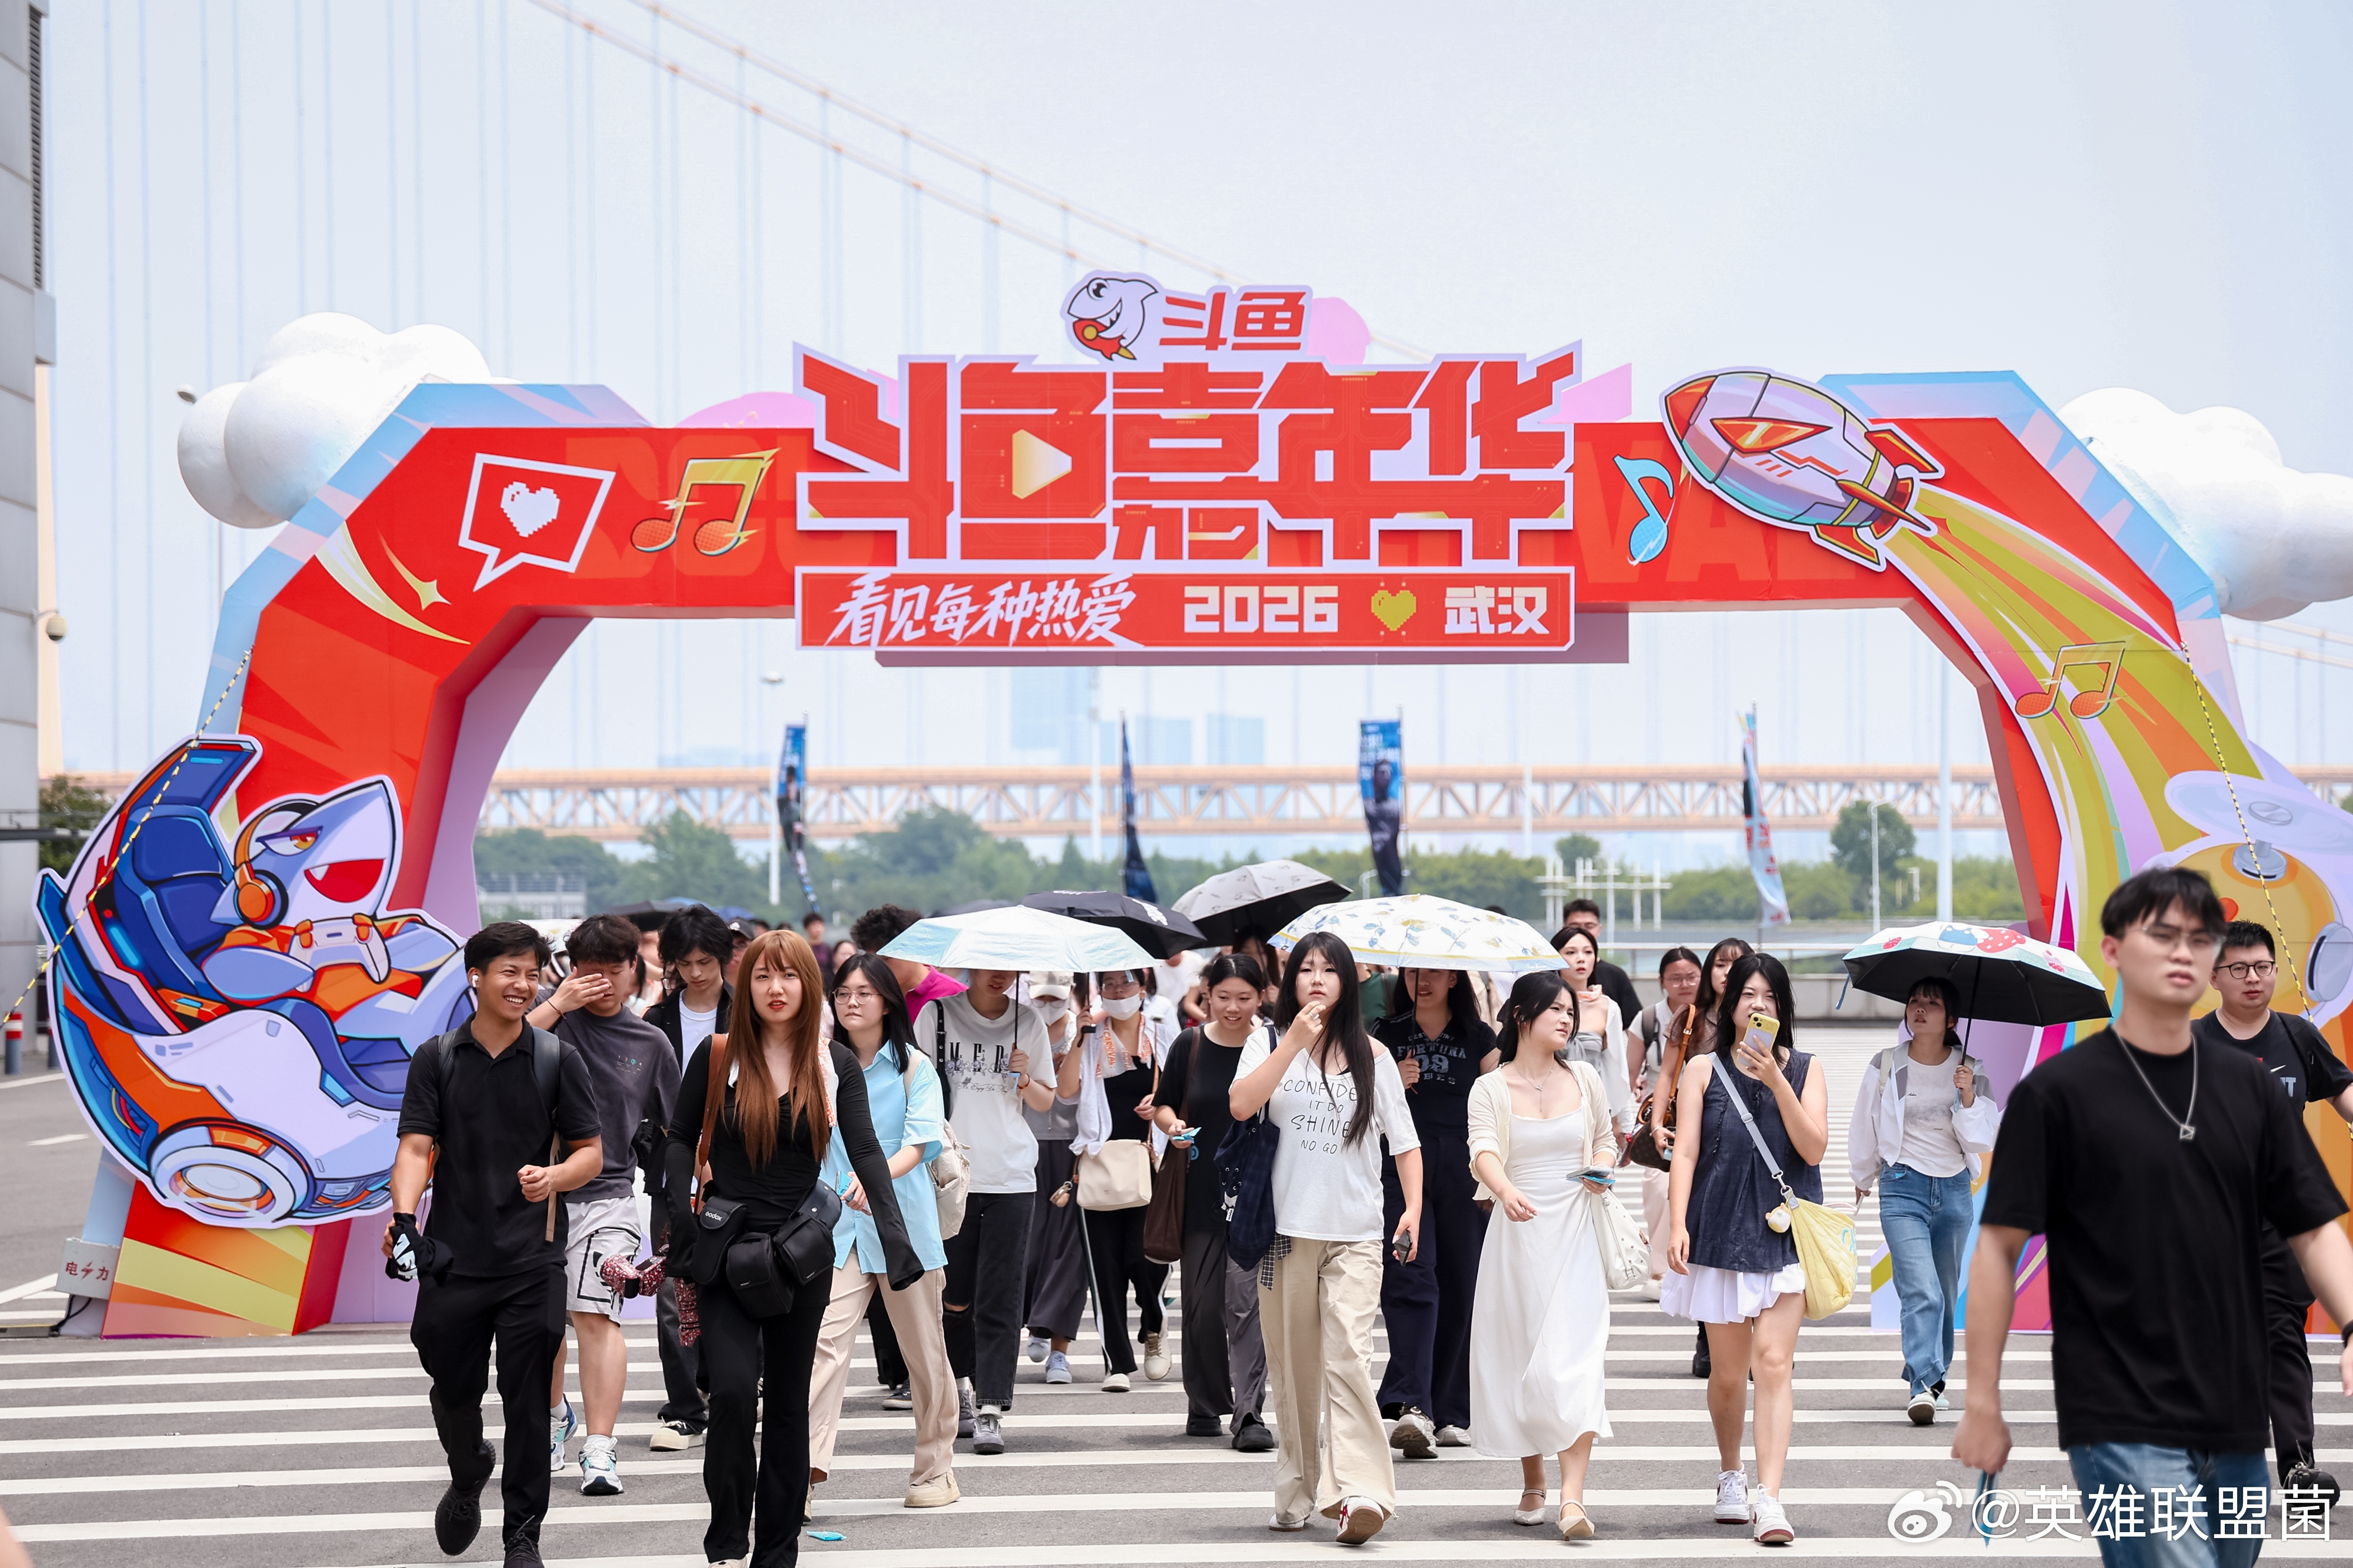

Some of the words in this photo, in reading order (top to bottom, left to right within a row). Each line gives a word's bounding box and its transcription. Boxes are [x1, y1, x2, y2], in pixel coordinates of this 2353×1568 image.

[1159, 291, 1307, 352] 斗鱼
[824, 572, 1145, 648] 看见每种热爱
[1184, 586, 1338, 634] 2026
[1444, 585, 1549, 634] 武汉
[1309, 1100, 1324, 1110] IT
[1328, 1102, 1344, 1113] DO
[1291, 1115, 1352, 1138] SHINE
[1301, 1140, 1317, 1151] NO
[1322, 1143, 1338, 1155] GO
[705, 1211, 722, 1221] Godox
